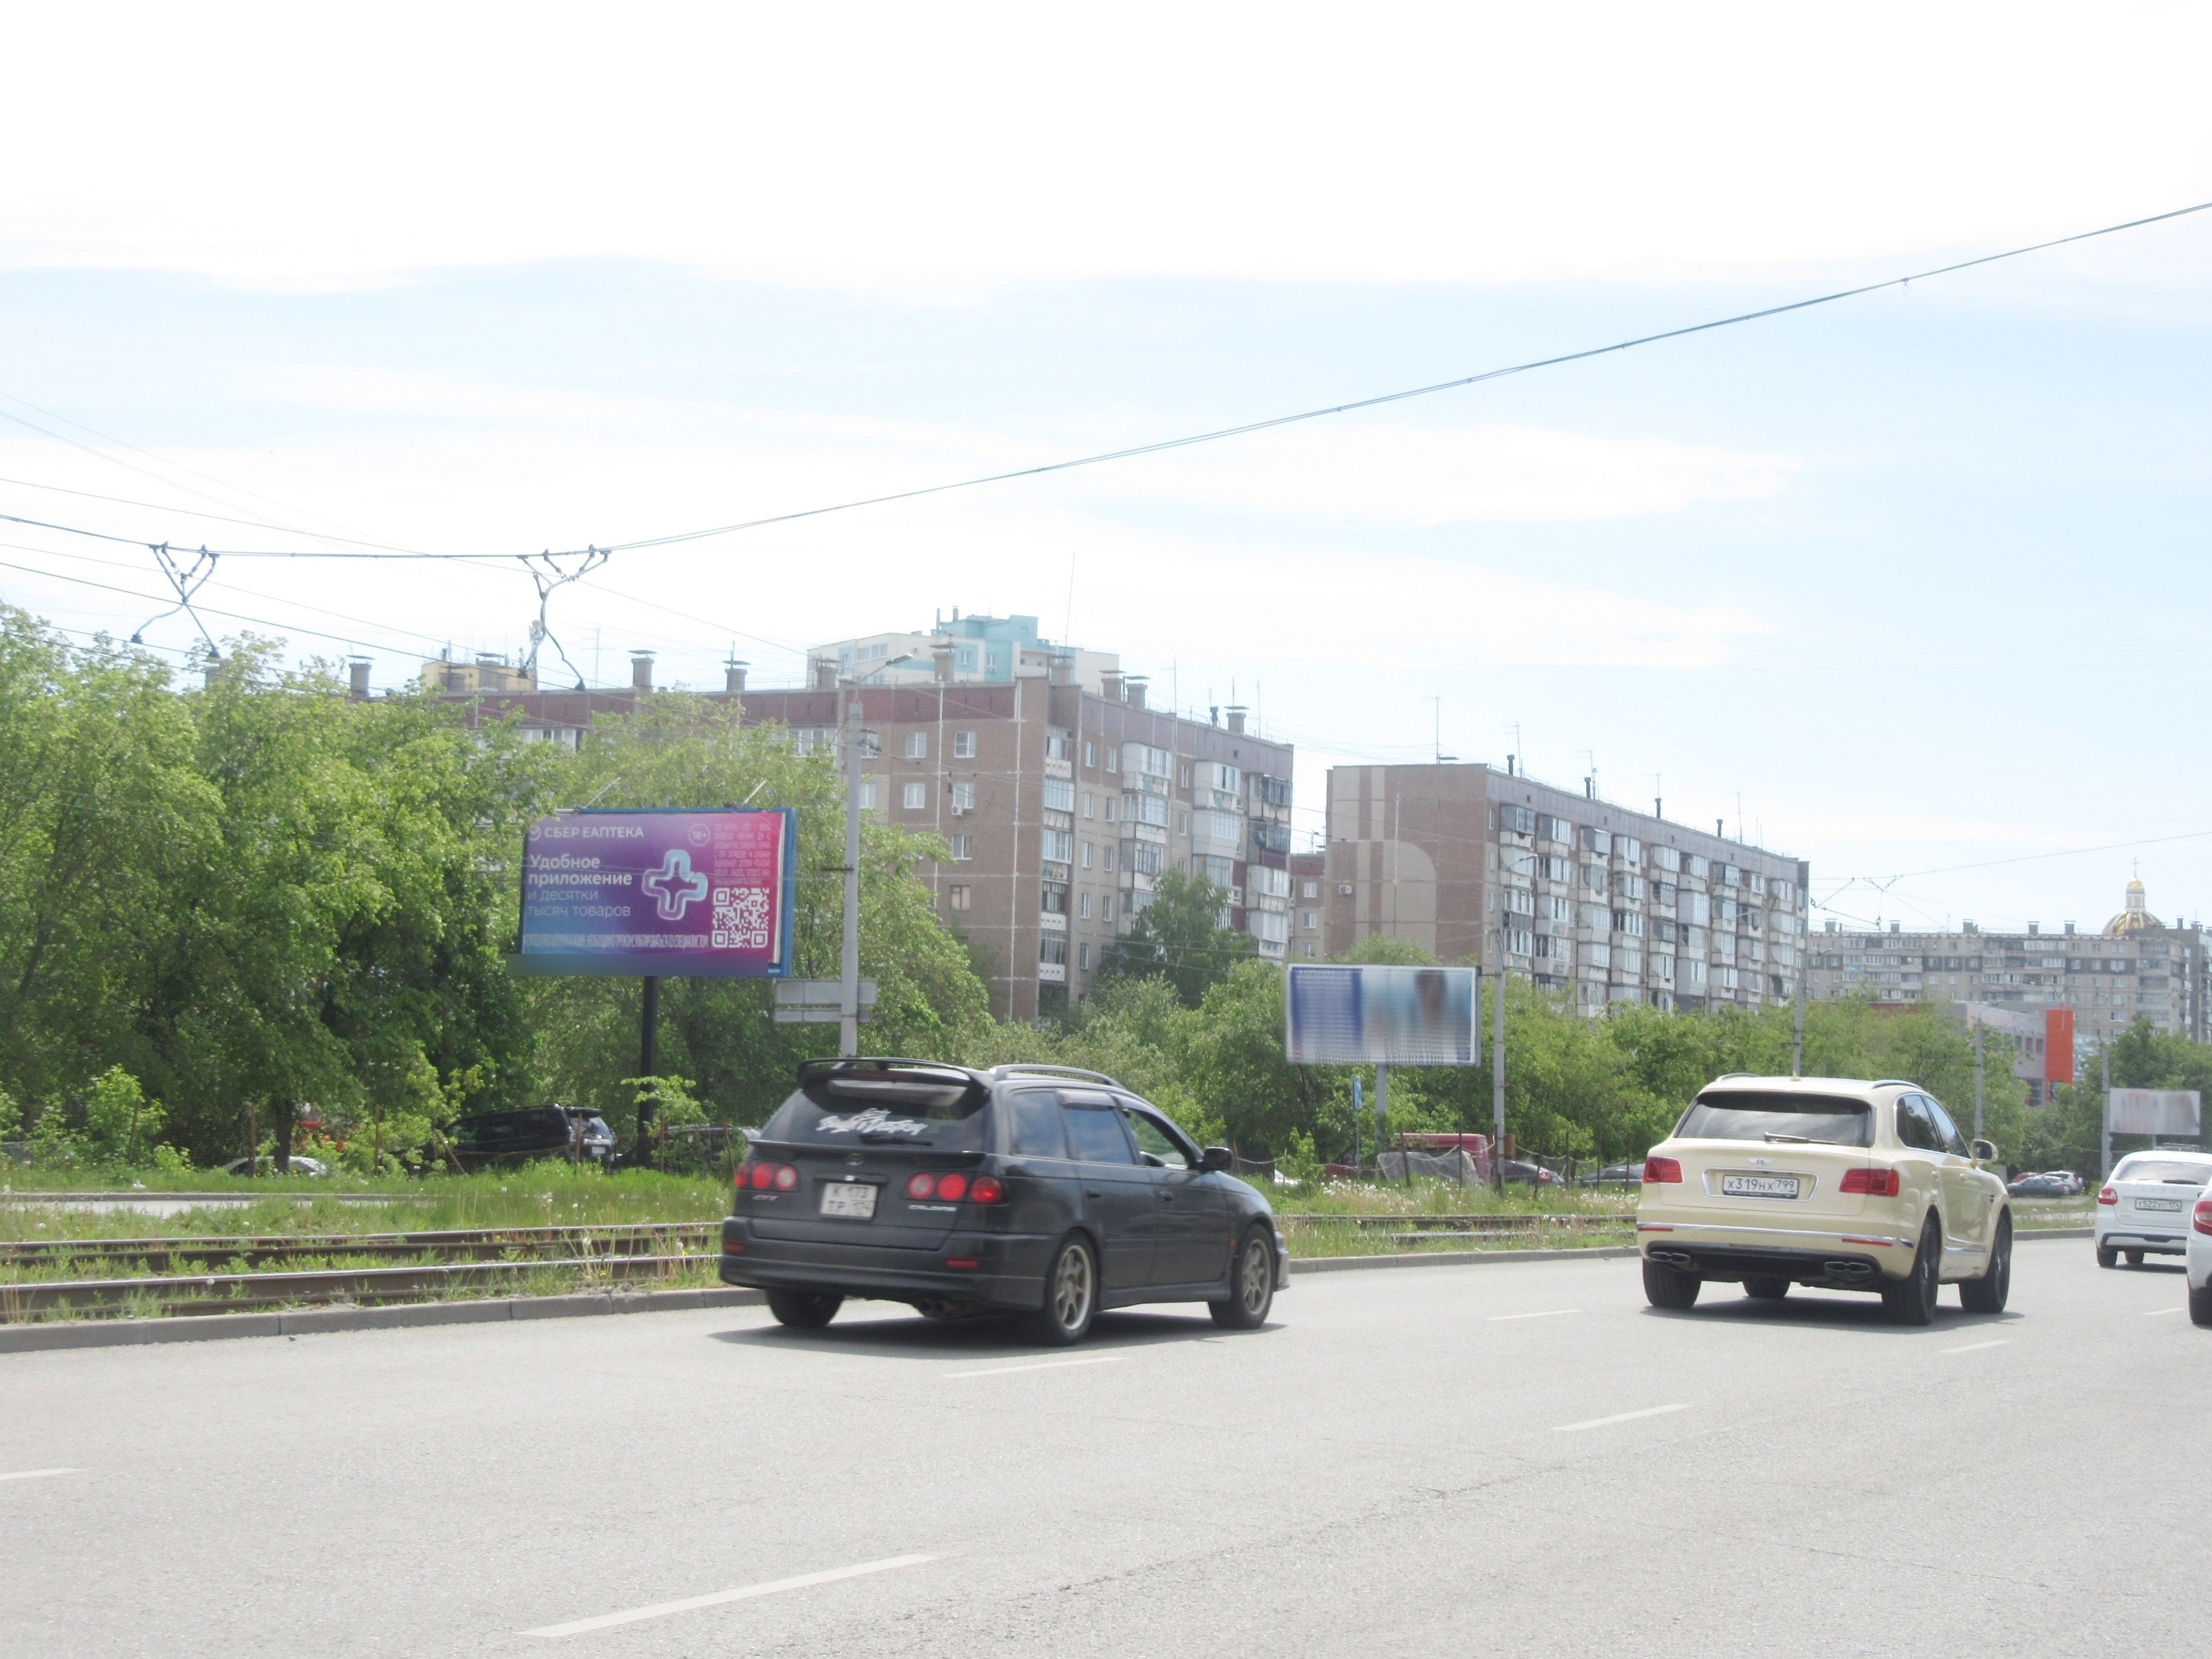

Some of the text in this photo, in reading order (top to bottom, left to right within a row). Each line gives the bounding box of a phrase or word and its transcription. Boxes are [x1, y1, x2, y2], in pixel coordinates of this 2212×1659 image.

[545, 826, 644, 838] СБЕР ЕАПТЕКА
[692, 830, 706, 840] 18+
[530, 853, 601, 870] Удобное
[529, 873, 632, 888] приложение
[528, 890, 598, 901] и десятки
[528, 905, 631, 918] тысяч товаров
[1776, 1179, 1795, 1189] 799
